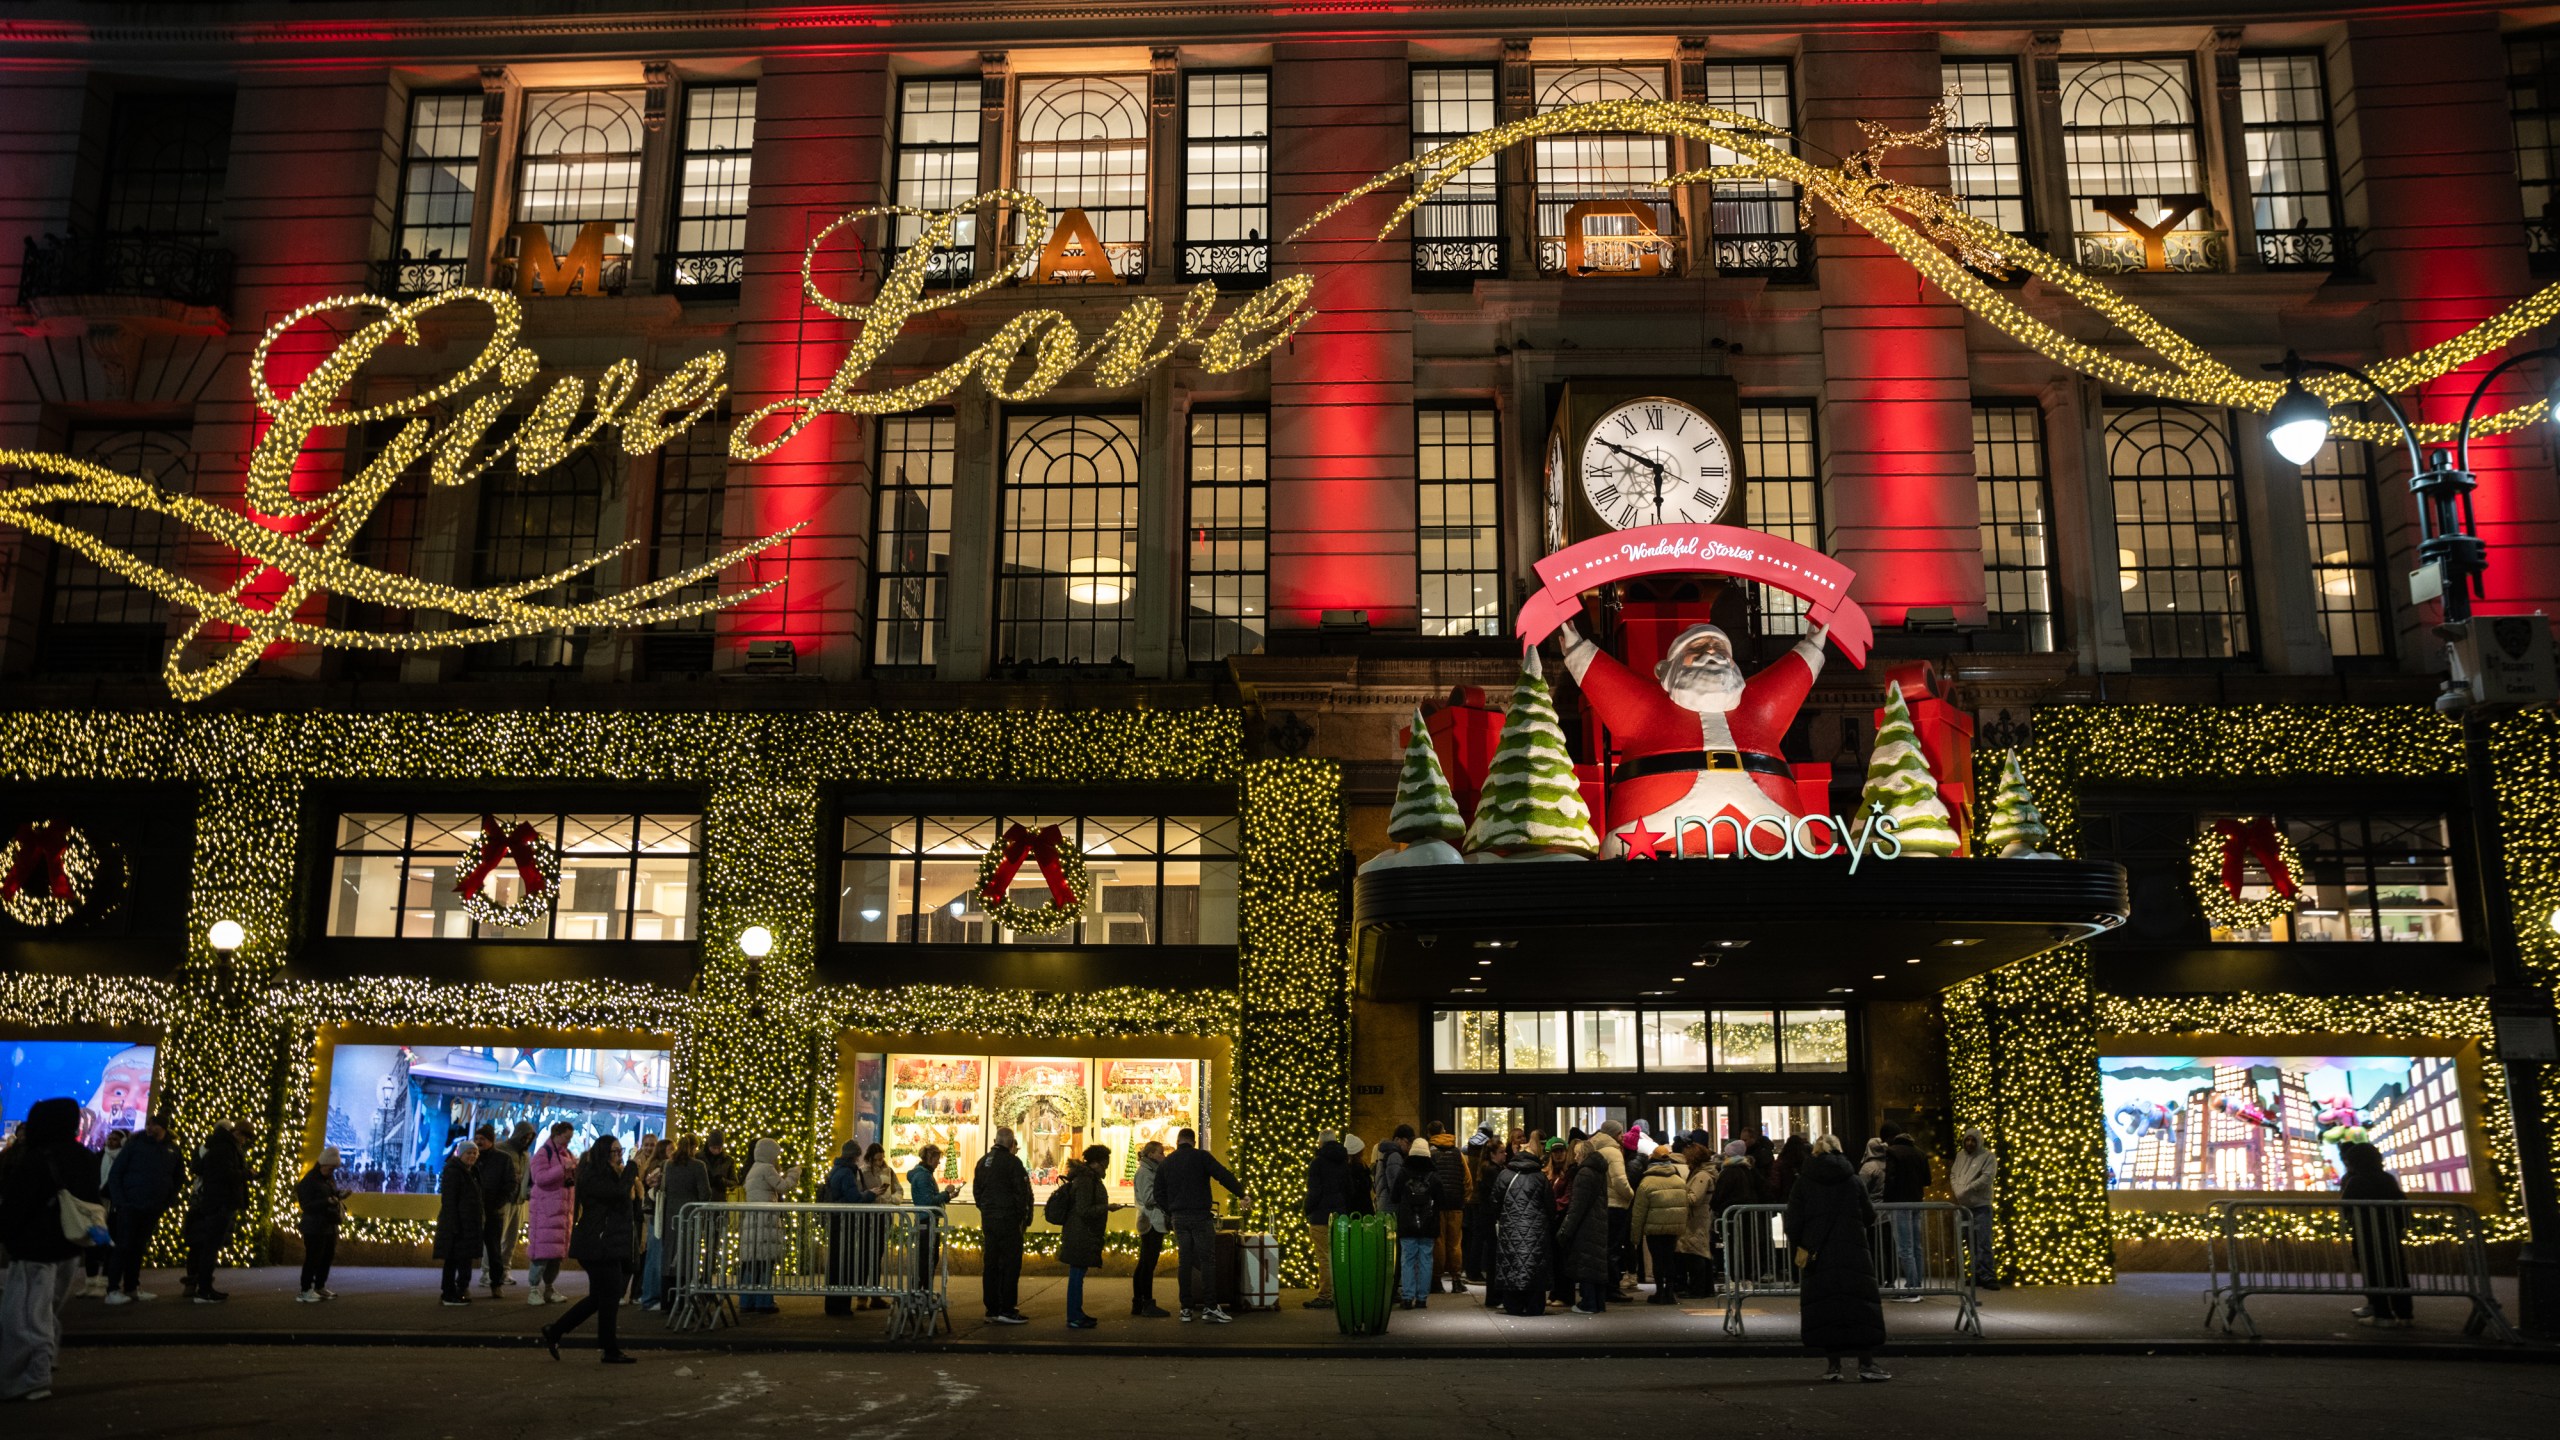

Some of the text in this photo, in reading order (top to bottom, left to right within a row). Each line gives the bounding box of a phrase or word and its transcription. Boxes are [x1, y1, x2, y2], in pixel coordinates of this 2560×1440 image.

[1645, 409, 1664, 430] XII
[164, 188, 1316, 702] Give Love
[1701, 466, 1724, 477] III
[1555, 536, 1836, 590] THE MOST Wonderful Stories START HERE
